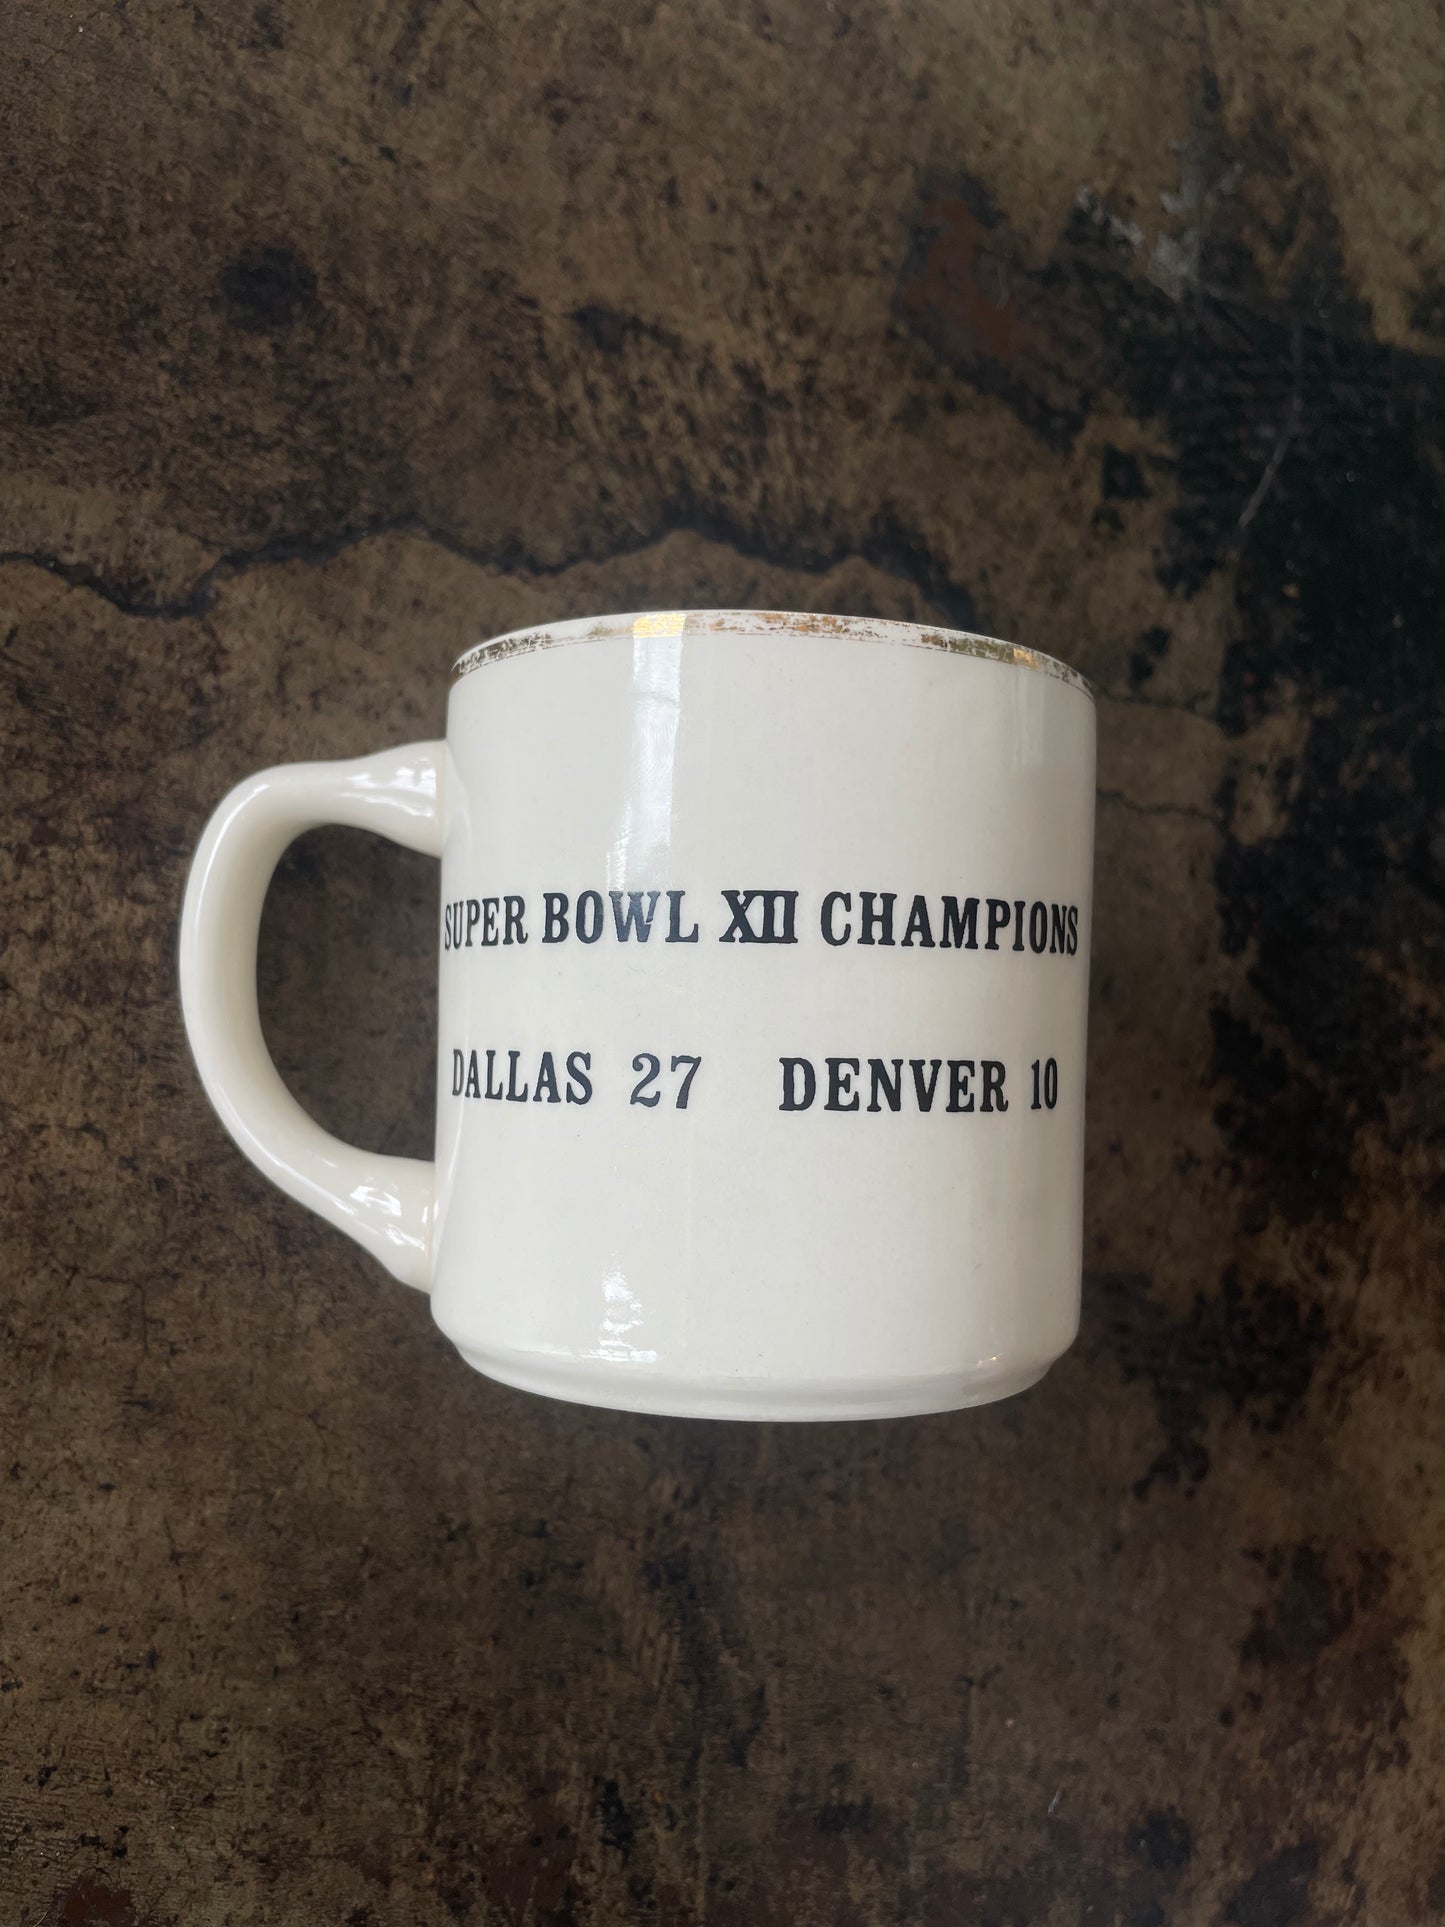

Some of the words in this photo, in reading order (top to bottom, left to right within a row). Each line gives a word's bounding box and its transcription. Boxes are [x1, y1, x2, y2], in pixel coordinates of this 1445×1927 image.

[444, 895, 529, 951] SUPER
[541, 889, 700, 944] BOWL
[718, 889, 799, 945] XII
[820, 890, 1079, 957] CHAMPIONS
[452, 1049, 593, 1106] DALLAS
[629, 1052, 702, 1110] 27
[778, 1057, 1010, 1113] DENVER
[1030, 1056, 1059, 1112] 10
